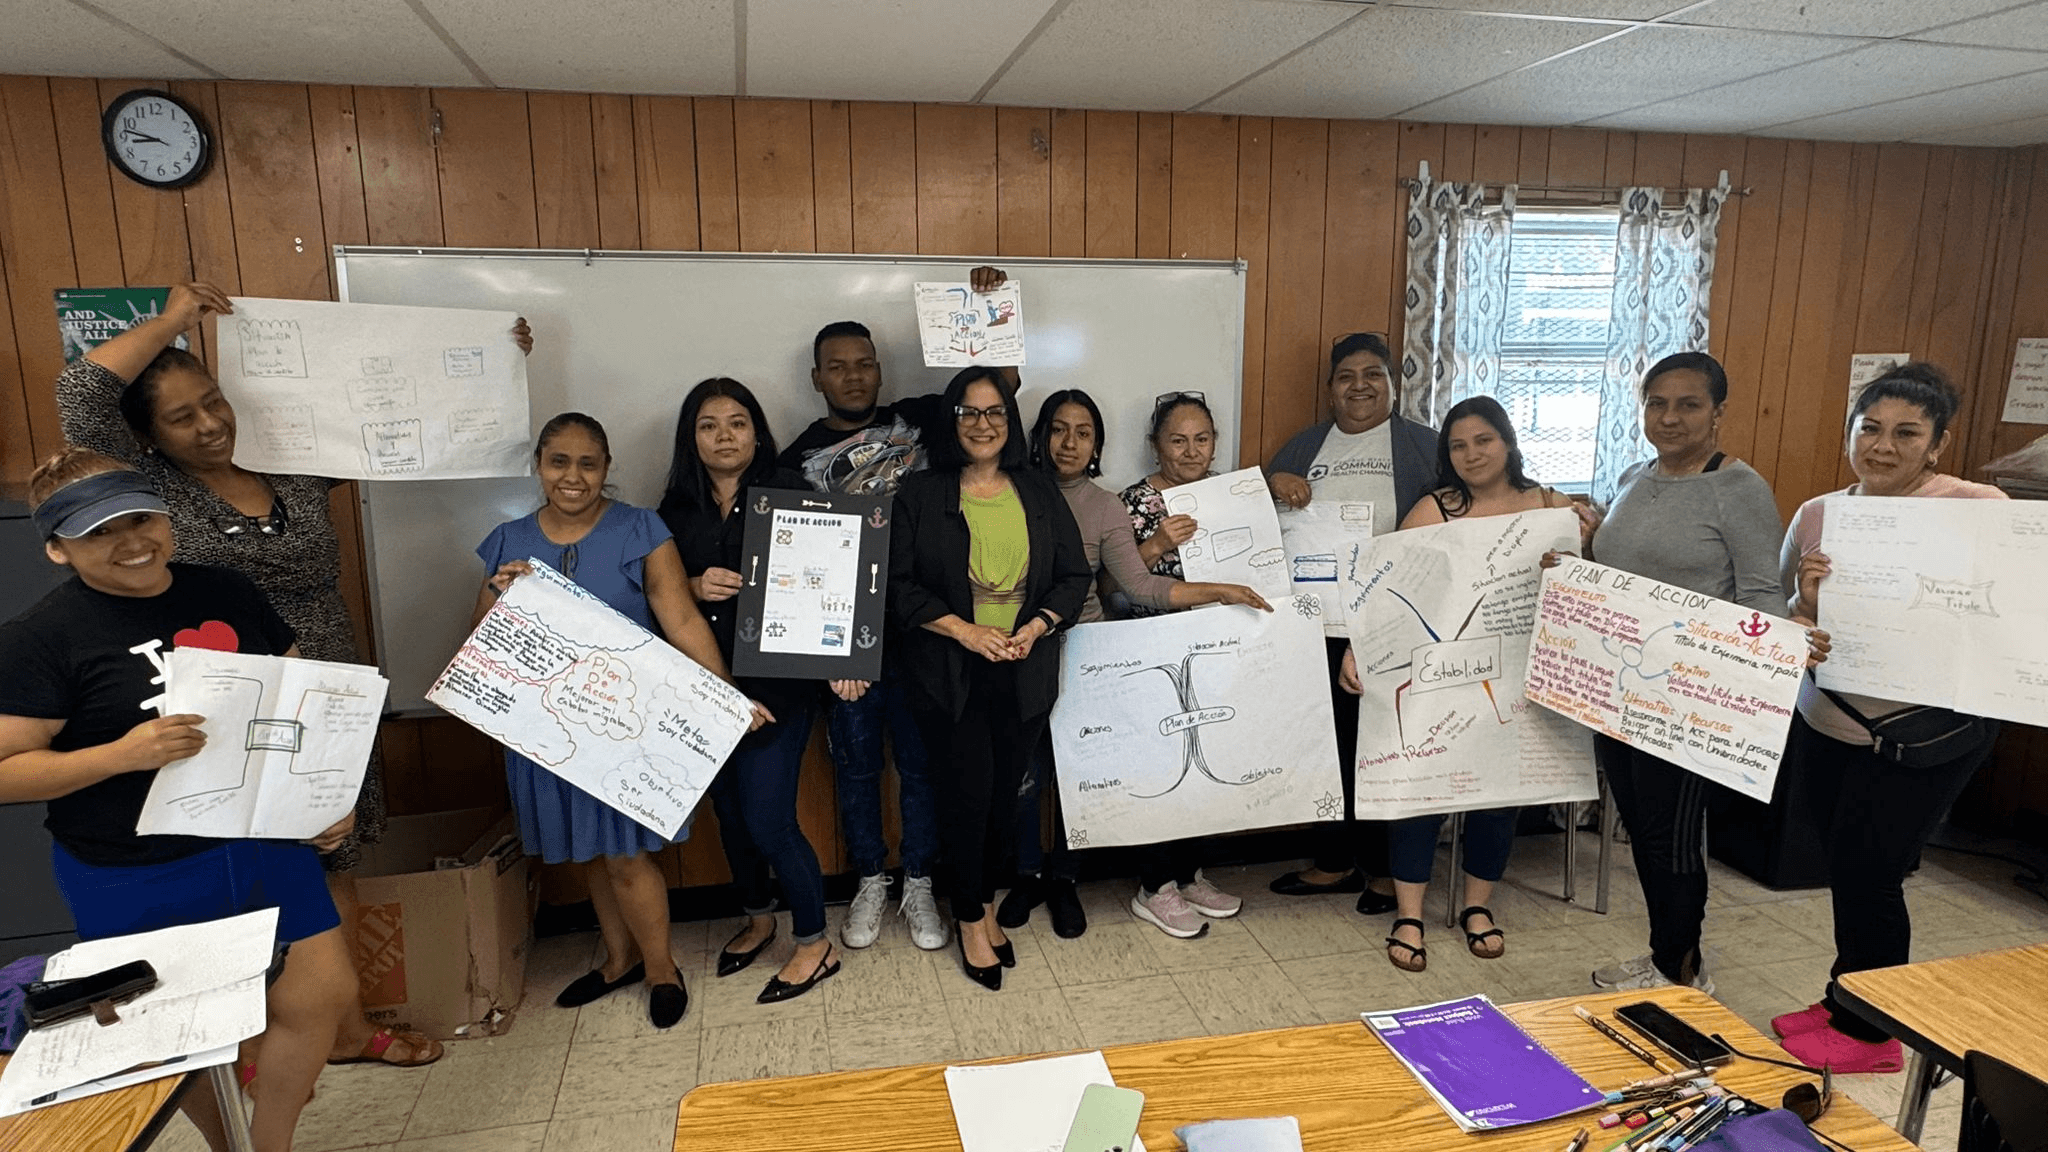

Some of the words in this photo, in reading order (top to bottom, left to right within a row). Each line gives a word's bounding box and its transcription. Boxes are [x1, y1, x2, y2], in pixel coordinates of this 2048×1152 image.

[135, 106, 146, 119] 11
[149, 102, 162, 115] 12
[171, 109, 176, 120] 1
[123, 117, 136, 130] 10
[182, 121, 191, 133] 2
[119, 131, 128, 143] 9
[190, 136, 197, 149] 3
[126, 147, 135, 159] 8
[183, 151, 192, 163] 4
[140, 160, 148, 172] 7
[157, 164, 166, 176] 6
[173, 162, 181, 174] 5
[64, 310, 96, 320] AND
[65, 320, 128, 330] JUSTICE
[84, 330, 112, 340] ALL
[1333, 461, 1391, 471] COMMUNI
[777, 515, 798, 525] PLAN
[800, 517, 811, 526] DE
[1568, 564, 1609, 585] PLAN
[1612, 574, 1636, 591] DE
[1649, 584, 1717, 610] ACCION
[1699, 641, 1708, 651] de
[1762, 662, 1775, 672] mi
[592, 656, 622, 683] Plan
[1419, 650, 1493, 683] Estabilidad
[1667, 685, 1679, 694] en
[1735, 692, 1747, 703] de
[1163, 716, 1185, 730] Plan
[1186, 714, 1196, 725] de
[658, 721, 677, 739] Soy
[1670, 722, 1684, 732] con
[1689, 727, 1705, 739] ACC
[1709, 734, 1731, 748] para
[1735, 738, 1746, 749] el
[1687, 739, 1704, 750] con
[621, 779, 642, 797] Ser
